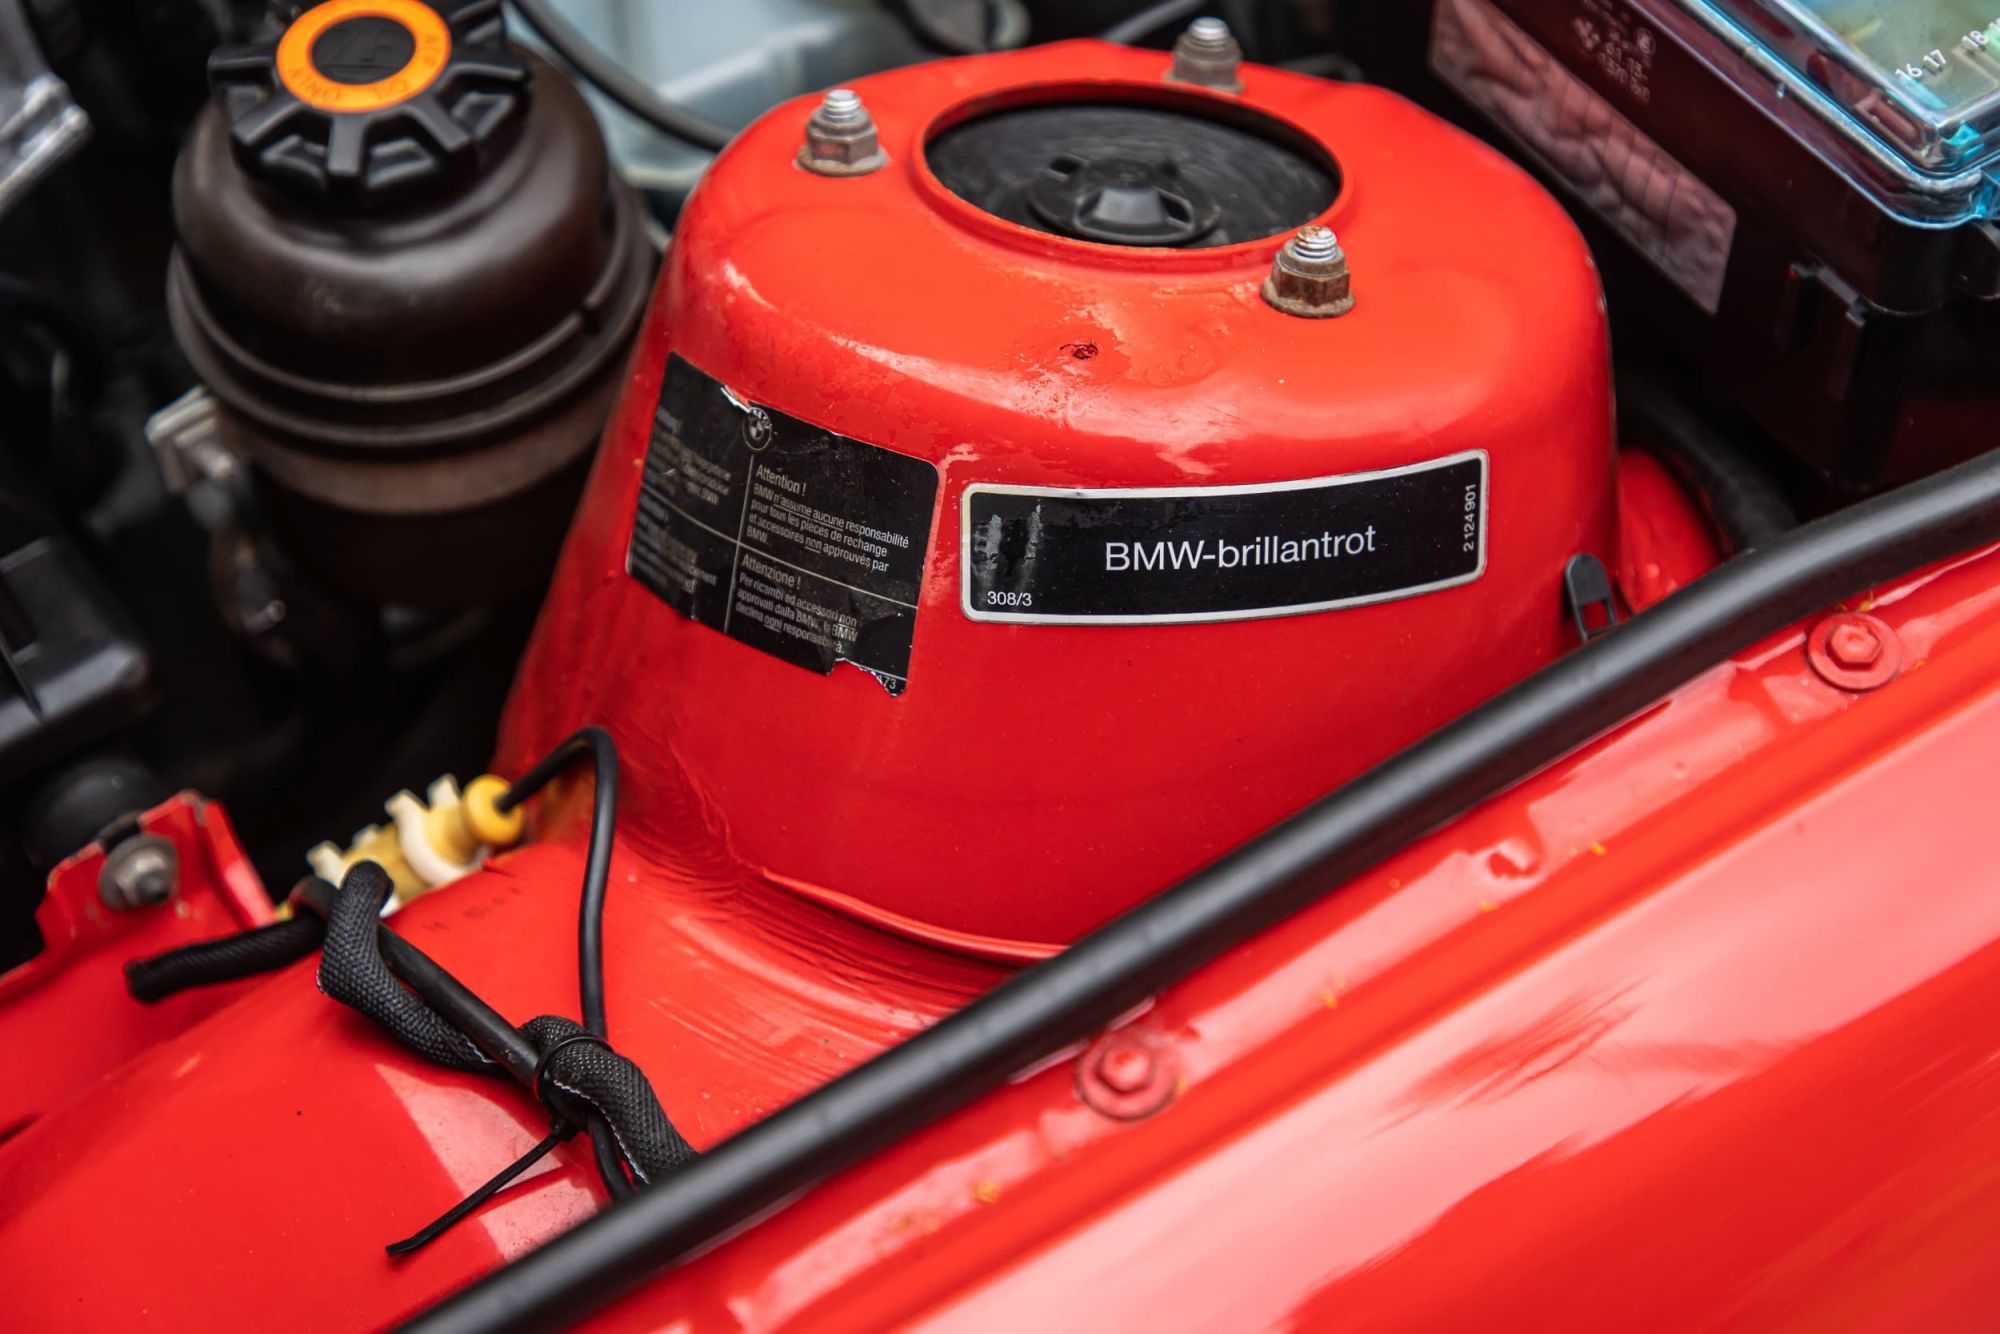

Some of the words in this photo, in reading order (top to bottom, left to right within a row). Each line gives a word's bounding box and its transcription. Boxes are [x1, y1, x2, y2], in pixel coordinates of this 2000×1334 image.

[1895, 63, 1922, 80] 16
[1923, 49, 1946, 67] 17
[1962, 30, 1988, 49] 18
[755, 464, 800, 494] Attention
[751, 499, 769, 514] pour
[769, 506, 787, 521] tous
[788, 512, 800, 527] les
[830, 528, 842, 542] de
[843, 535, 888, 557] rechange
[753, 483, 774, 501] BMW
[813, 509, 845, 527] aucune
[845, 520, 909, 549] responsabilité
[749, 513, 757, 524] et
[757, 519, 804, 544] accessoires
[805, 536, 822, 550] non
[823, 543, 871, 568] approuvés
[872, 559, 890, 572] par
[1105, 525, 1376, 571] BMW-brillantrot
[741, 554, 795, 587] Attenzione
[736, 602, 764, 622] declina
[764, 615, 782, 630] ogni
[737, 588, 774, 612] approvati
[774, 604, 795, 620] dalla
[832, 623, 858, 642] BMW
[740, 572, 752, 587] Per
[753, 580, 785, 601] ricambi
[785, 591, 796, 605] ed
[796, 598, 838, 621] accessori
[838, 613, 857, 627] non
[987, 591, 1032, 606] 308/3
